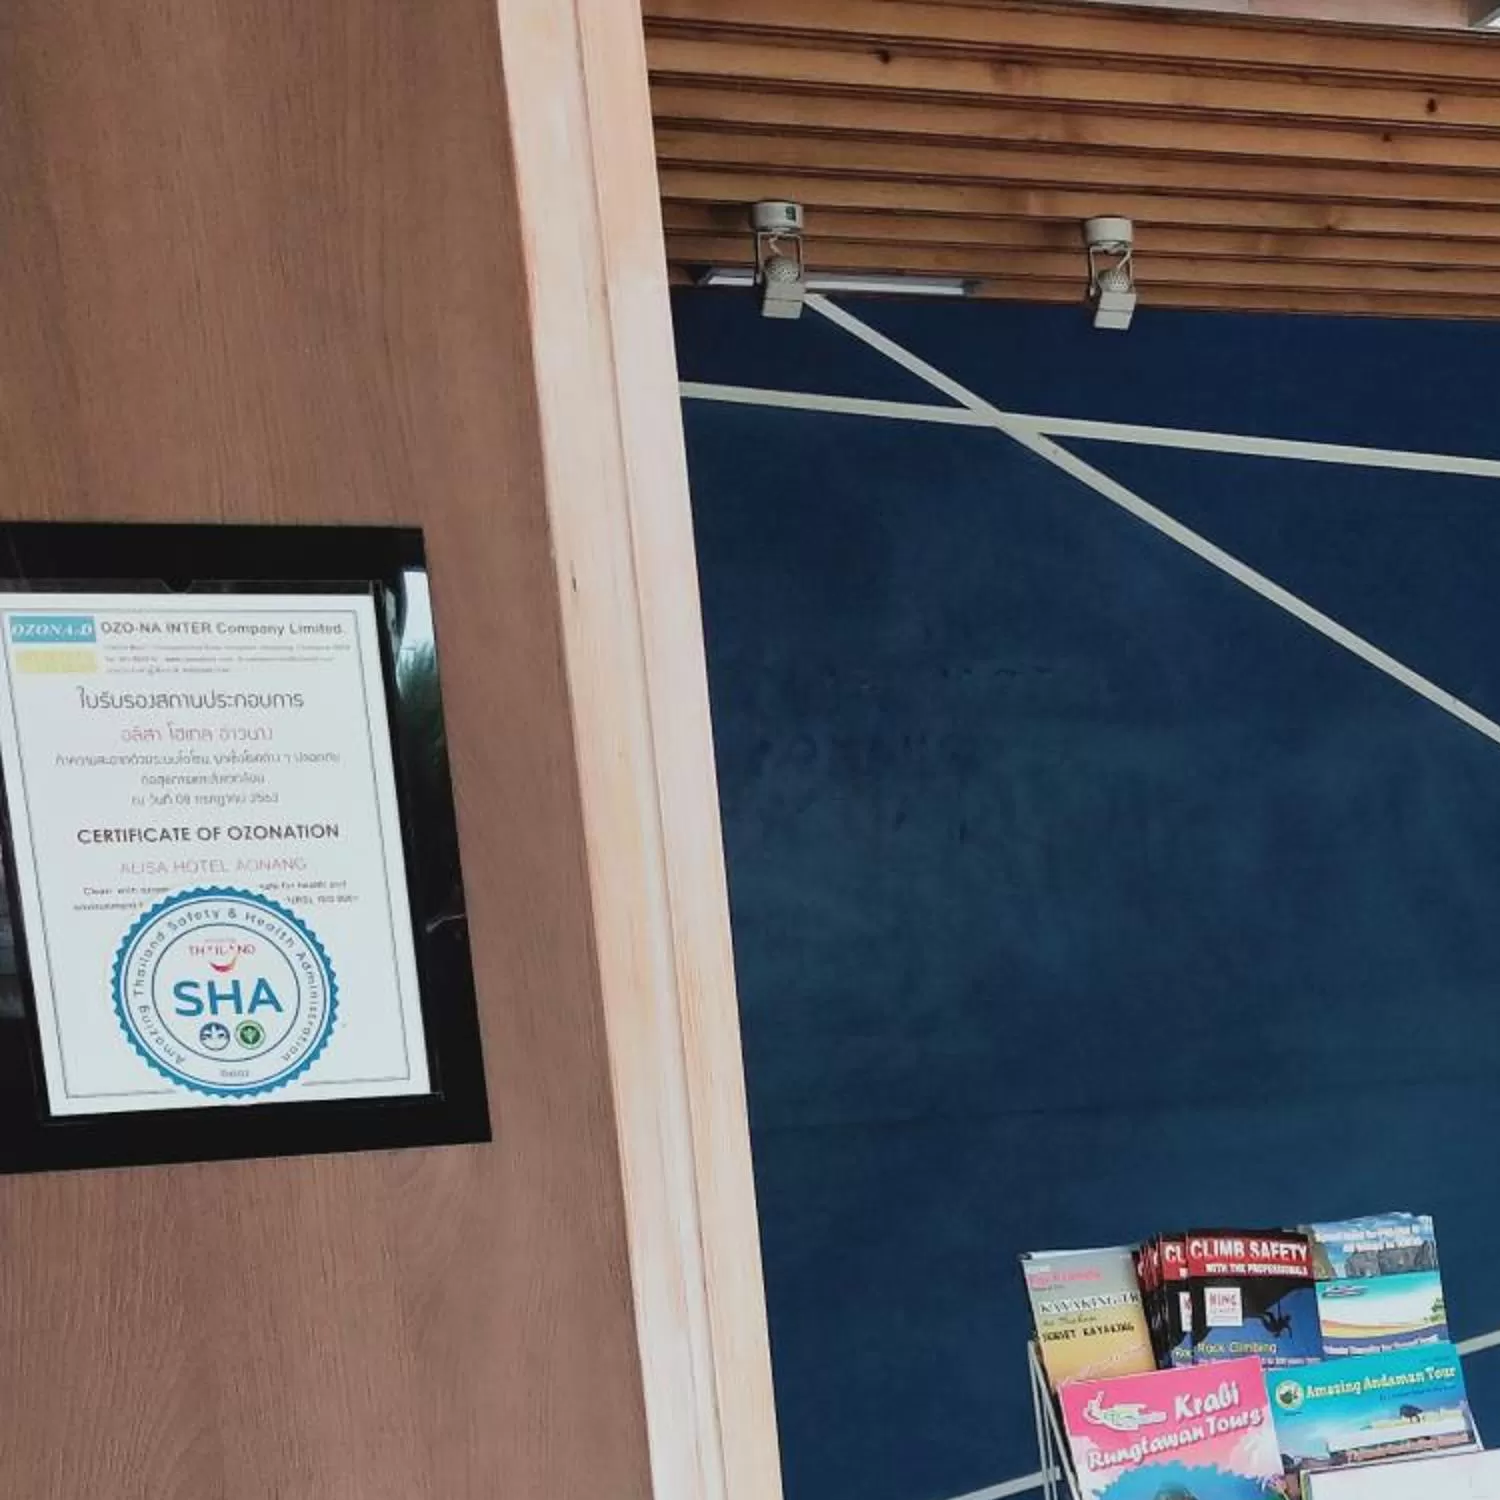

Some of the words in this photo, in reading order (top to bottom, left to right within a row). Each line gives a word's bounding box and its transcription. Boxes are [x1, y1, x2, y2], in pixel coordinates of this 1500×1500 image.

[166, 621, 211, 635] INTER
[216, 622, 285, 637] Company
[77, 827, 192, 844] CERTIFICATE
[197, 826, 222, 841] OF
[227, 823, 339, 840] OZONATION
[120, 862, 168, 875] ALISA
[173, 860, 229, 874] HOTEL
[236, 857, 307, 872] AONANG
[167, 908, 220, 931] Safety
[228, 908, 237, 919] &
[245, 911, 296, 948] Health
[133, 933, 166, 996] Thailand
[173, 977, 284, 1017] SHA
[281, 952, 319, 1062] Administration
[137, 1004, 187, 1066] Amazing
[1189, 1239, 1245, 1259] CLIMB
[1249, 1241, 1307, 1262] SAFETY
[1082, 1322, 1135, 1336] KAYAKING
[1306, 1380, 1361, 1400] Amazing
[1363, 1373, 1425, 1391] Andaman
[1425, 1366, 1457, 1381] Tour
[1173, 1380, 1241, 1421] Krabi
[1206, 1407, 1264, 1436] Tours
